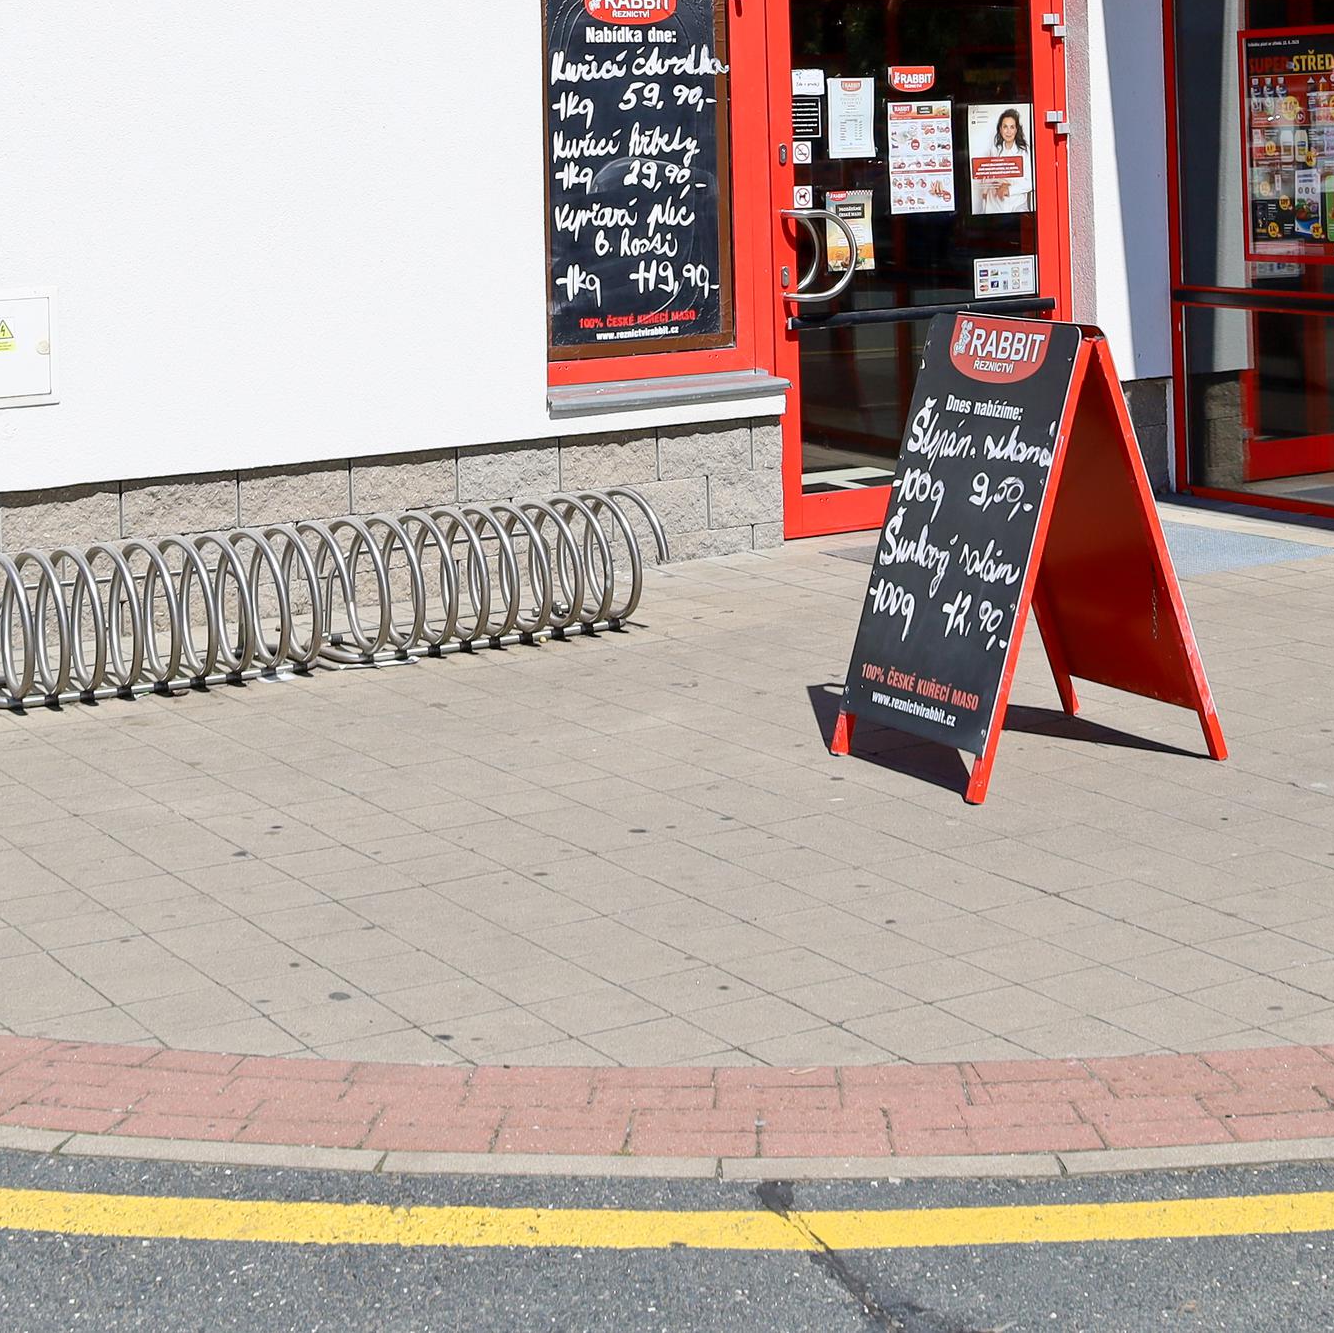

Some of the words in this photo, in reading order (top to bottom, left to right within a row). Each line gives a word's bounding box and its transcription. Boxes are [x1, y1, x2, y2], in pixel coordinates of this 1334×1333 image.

[612, 9, 650, 18] ŘEZNICTVÍ
[585, 25, 643, 43] Nabídka
[647, 27, 677, 43] dne:
[900, 73, 933, 84] RABBIT
[579, 317, 604, 329] 100%
[606, 313, 635, 328] ČESKÉ
[671, 309, 696, 322] MASO
[596, 326, 680, 341] www.reznictvirabbit.cz
[969, 328, 1045, 363] RABBIT
[973, 357, 1014, 374] ŘEZNICTVÍ
[945, 394, 972, 414] Dnes
[973, 400, 1024, 421] nabízíme:
[879, 506, 959, 598] Šunkový
[958, 539, 1021, 585] salám
[861, 662, 885, 684] 100%
[887, 665, 916, 692] ČESKÉ
[916, 678, 952, 703] KUŘECÍ
[951, 689, 980, 711] MASO
[871, 691, 957, 727] www.reznictvirabbit.cz
